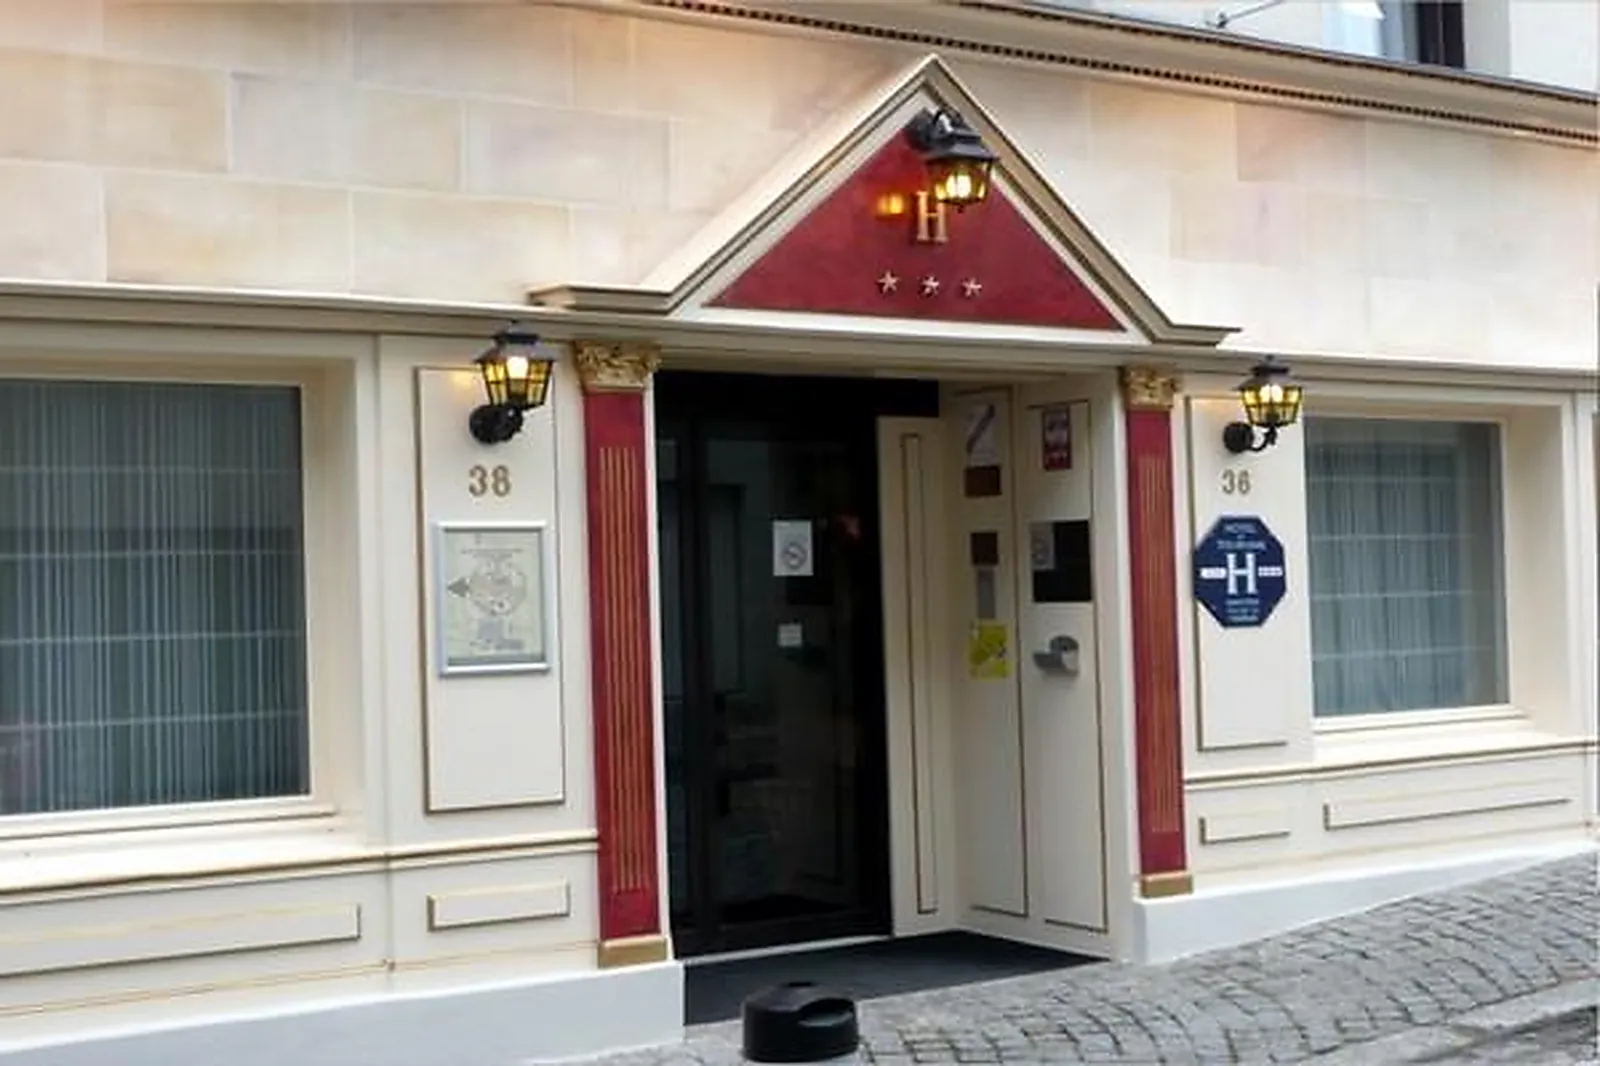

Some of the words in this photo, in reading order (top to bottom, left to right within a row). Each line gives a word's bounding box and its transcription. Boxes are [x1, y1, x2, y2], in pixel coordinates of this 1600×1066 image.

[916, 190, 949, 243] H
[468, 464, 512, 498] 38
[1221, 468, 1251, 495] 36
[1226, 553, 1258, 595] H
